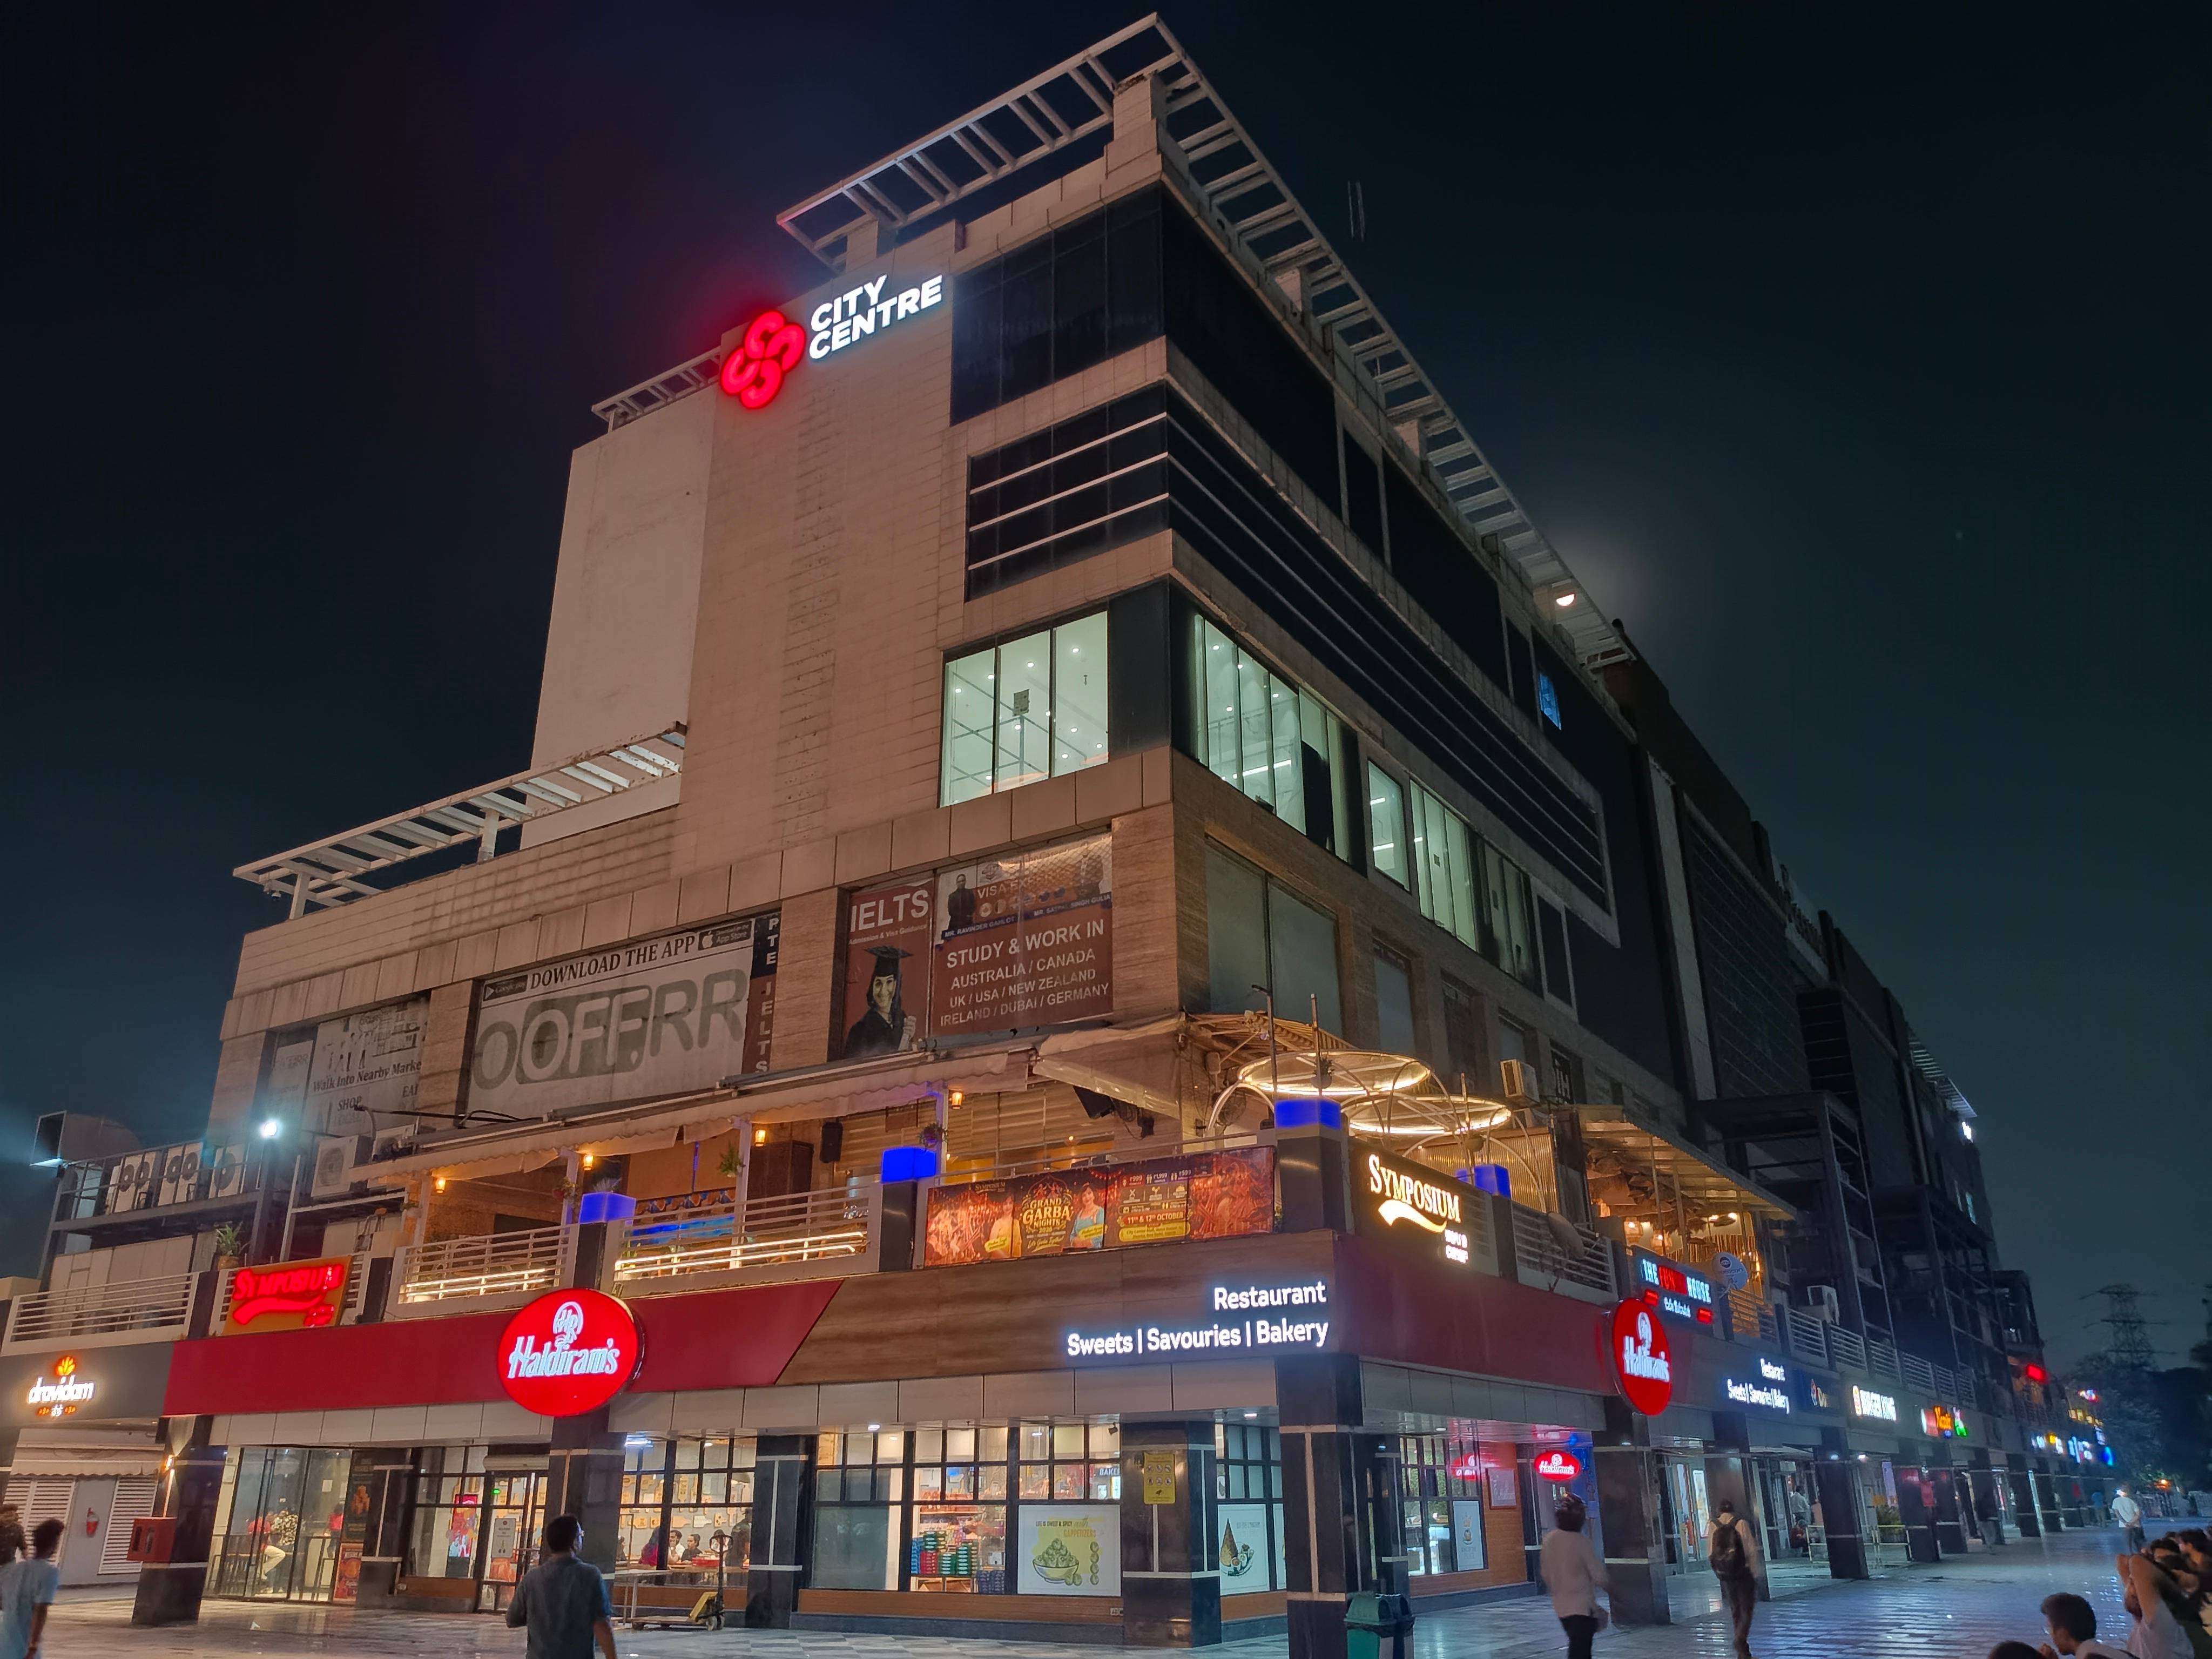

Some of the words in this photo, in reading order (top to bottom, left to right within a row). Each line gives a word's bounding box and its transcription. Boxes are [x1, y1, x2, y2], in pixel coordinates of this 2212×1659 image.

[809, 274, 942, 359] CENTRE
[811, 274, 887, 331] CITY
[851, 889, 929, 933] IELTS
[977, 884, 1007, 899] VISA
[530, 954, 620, 989] DOWNLOAD
[626, 944, 658, 966] THE
[662, 935, 695, 957] APP
[947, 943, 1004, 969] STUDY
[1008, 938, 1020, 955] &
[1026, 928, 1081, 952] WORK
[1087, 919, 1104, 938] IN
[950, 996, 965, 1009] UK
[976, 987, 1000, 1003] USA
[1008, 979, 1036, 997] NEW
[1038, 969, 1096, 991] ZEALAND
[951, 963, 1026, 990] AUSTRALIA
[1036, 948, 1096, 972] CANADA
[940, 1009, 990, 1027] IRELAND
[1001, 1000, 1037, 1016] DUBAI
[1047, 983, 1109, 1007] GERMANY
[313, 1077, 335, 1092] Walk
[336, 1075, 355, 1087] Into
[358, 1067, 390, 1082] Nearby
[338, 1095, 362, 1111] SHOP
[1030, 1198, 1062, 1209] GRAND
[1368, 1154, 1461, 1223] SYMPOSIUM
[1022, 1205, 1071, 1225] GARBA
[1034, 1218, 1061, 1229] NIGHTS
[1157, 1212, 1184, 1221] OCTOBER
[1214, 1281, 1327, 1310] Restaurant
[508, 1336, 619, 1379] Haldiram's
[1067, 1331, 1134, 1357] Sweets
[1147, 1324, 1242, 1351] Savouries
[1257, 1318, 1328, 1347] Bakery
